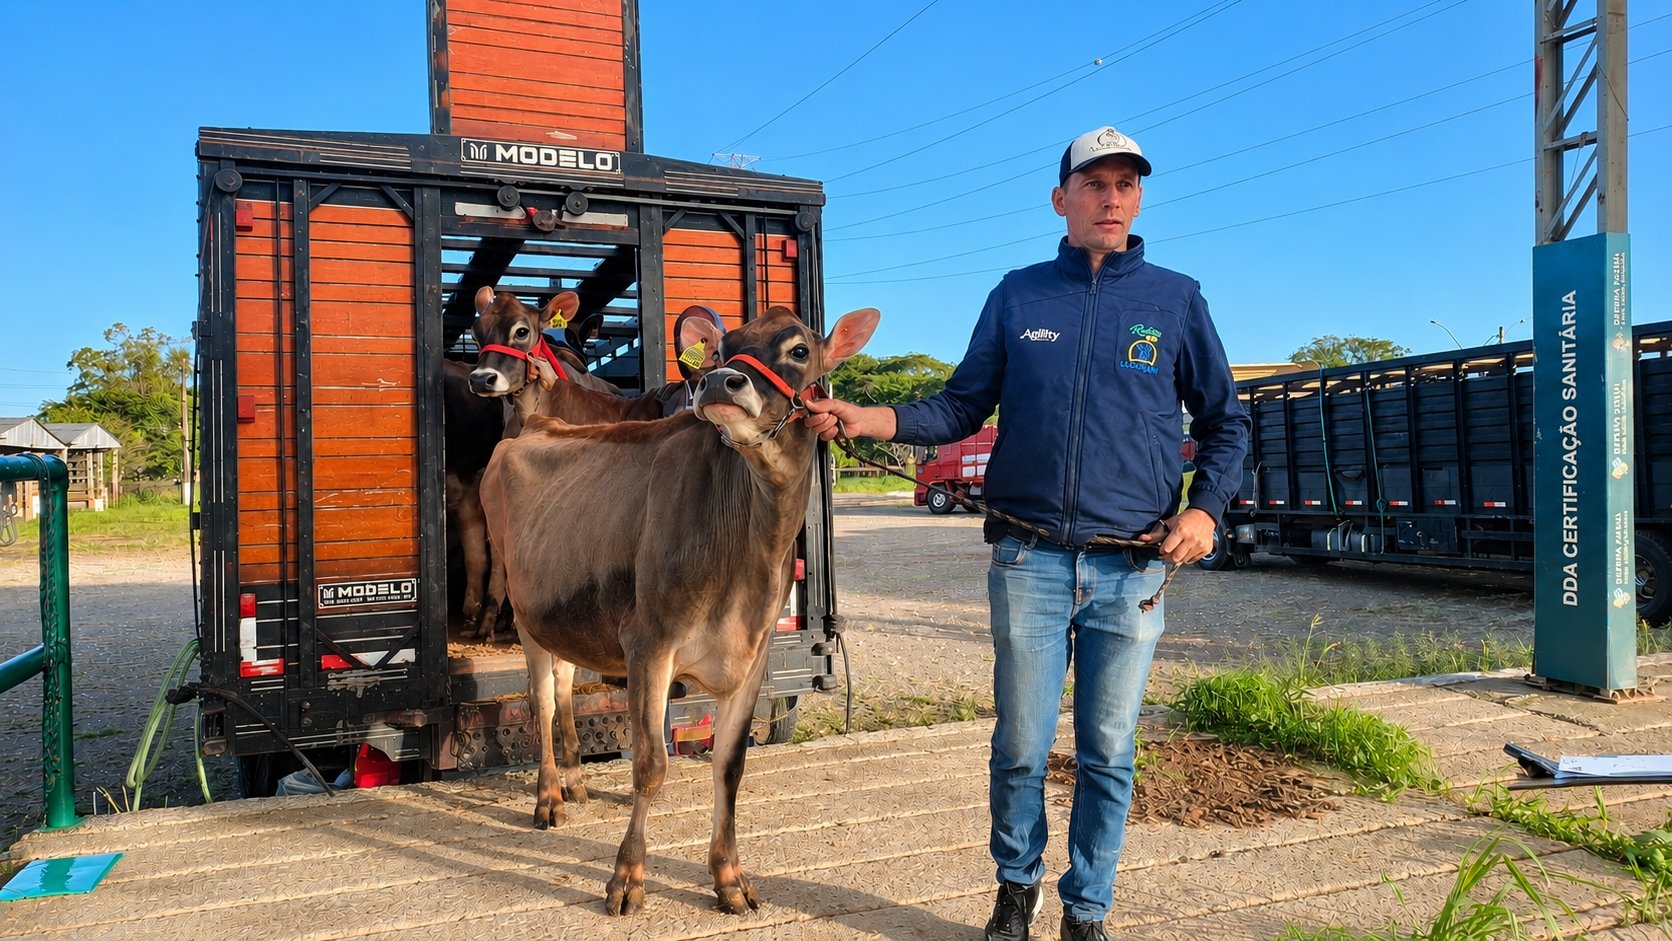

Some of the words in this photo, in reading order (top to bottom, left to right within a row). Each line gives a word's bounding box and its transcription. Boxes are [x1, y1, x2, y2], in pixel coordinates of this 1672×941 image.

[495, 144, 613, 171] MODELO
[1019, 327, 1061, 342] Agility
[1558, 289, 1578, 401] SANITÁRIA
[1558, 405, 1582, 558] CERTIFICAÇÃO
[337, 582, 412, 598] MODELO
[1562, 562, 1578, 607] DDA
